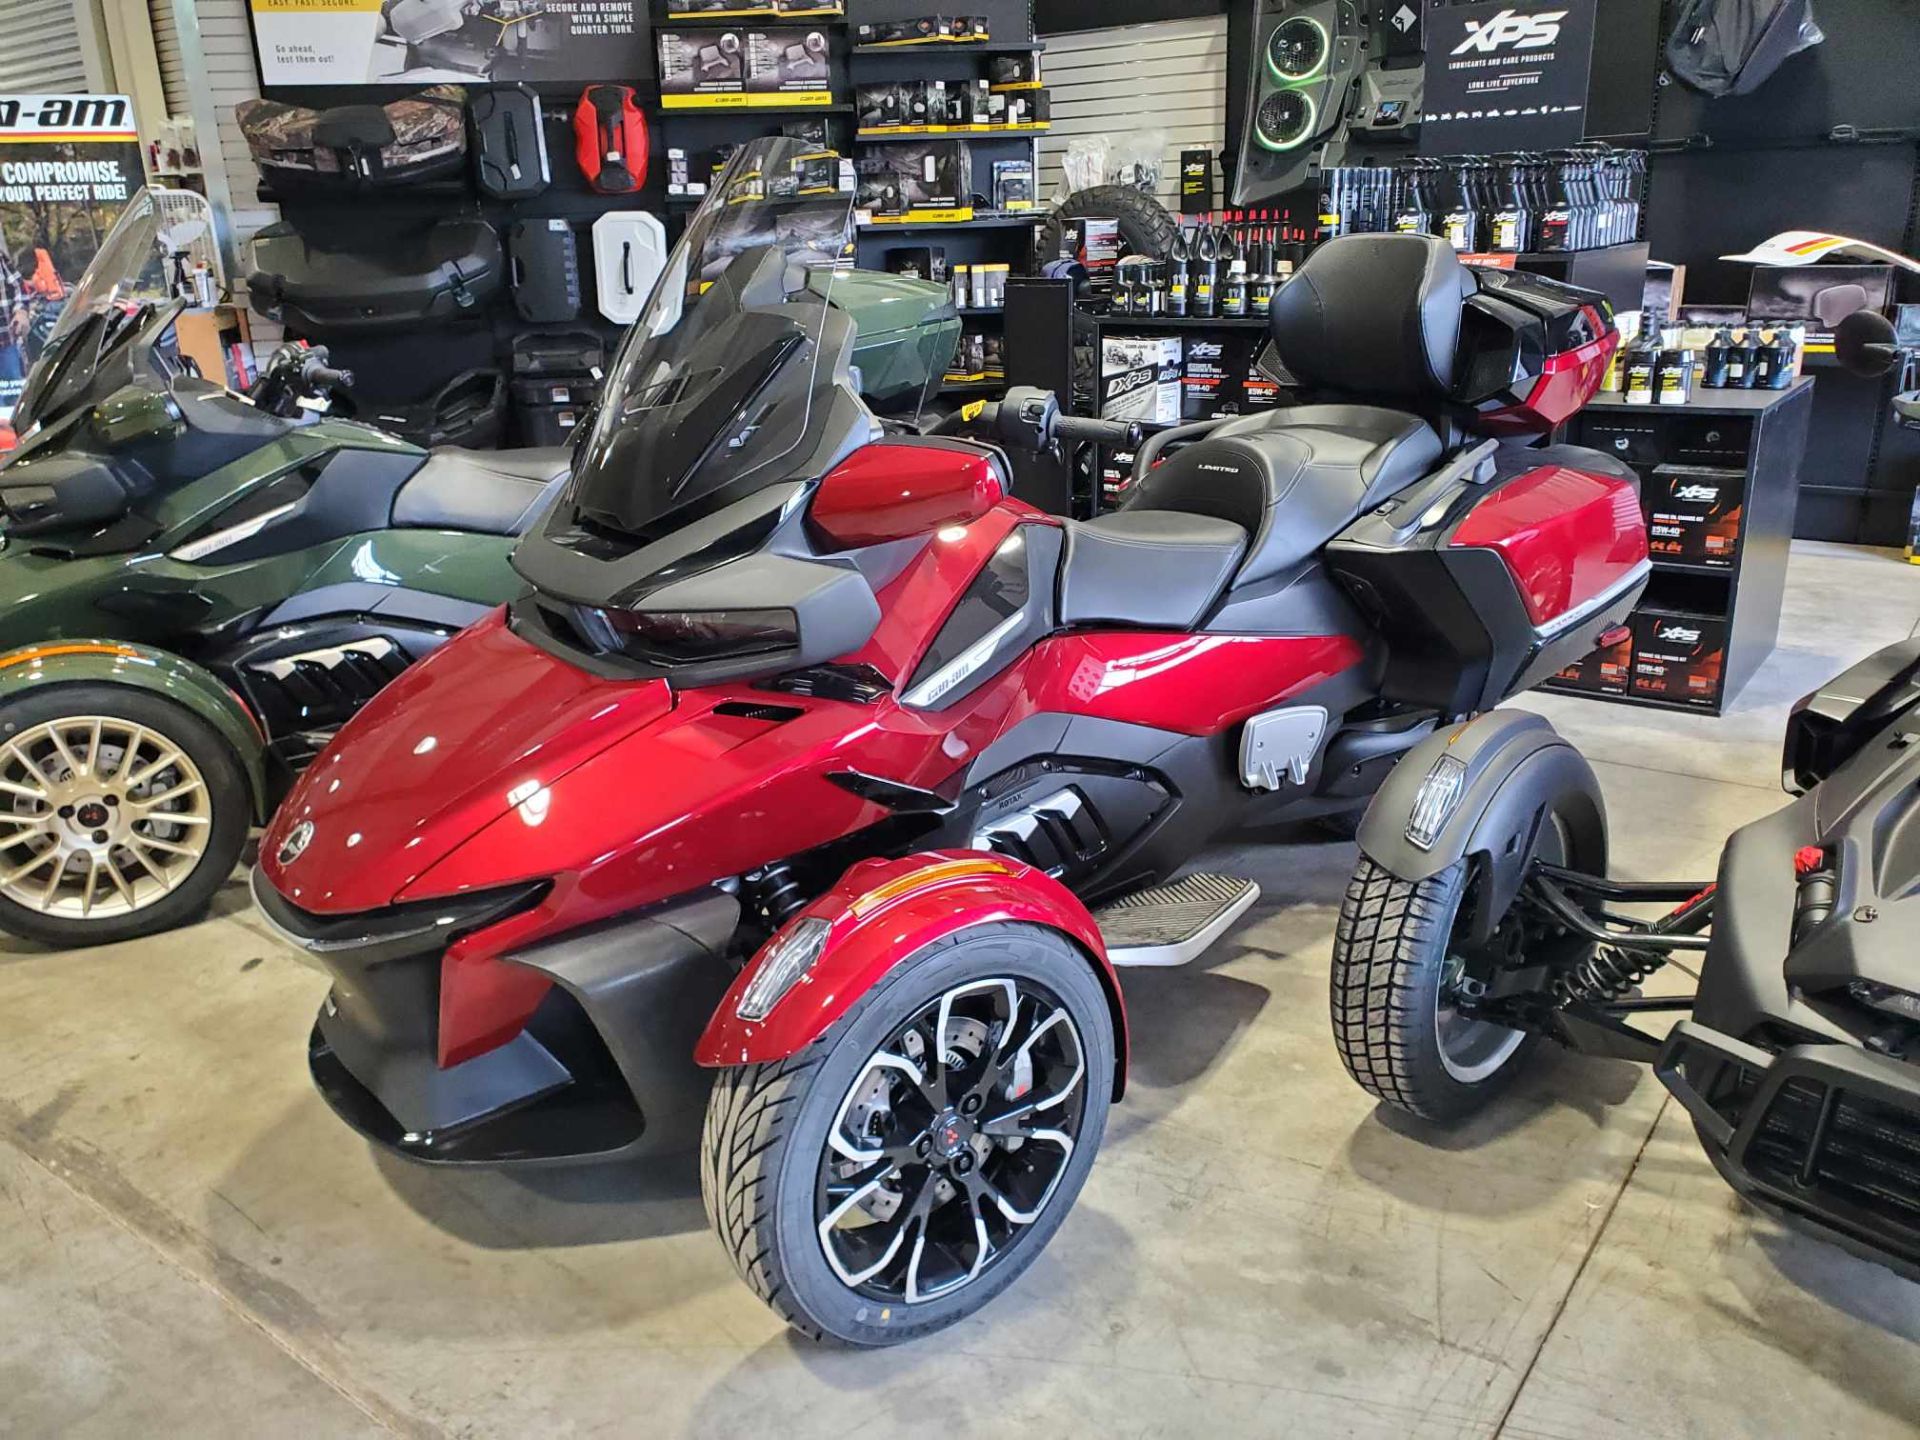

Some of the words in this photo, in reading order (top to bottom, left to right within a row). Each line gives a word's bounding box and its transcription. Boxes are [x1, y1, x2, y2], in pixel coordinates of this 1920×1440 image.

[546, 3, 578, 12] SECURE
[580, 3, 597, 12] AND
[600, 2, 633, 11] REMOVE
[571, 14, 593, 23] WITH
[596, 14, 601, 23] A
[604, 13, 634, 22] SIMPLE
[570, 25, 608, 34] QUARTER
[1450, 9, 1569, 55] XPS
[277, 55, 294, 63] test
[296, 55, 316, 63] them
[1448, 60, 1487, 70] LUBRICANTS
[1488, 58, 1501, 67] AND
[1503, 56, 1520, 65] CARE
[1521, 53, 1555, 63] PRODUCTS
[1468, 81, 1485, 89] LONG
[1487, 79, 1501, 88] LIVE
[1503, 76, 1539, 86] ADVENTURE
[2, 161, 127, 184] COMPROMISE.
[35, 185, 90, 201] PERFECT
[92, 184, 127, 200] RIDE!
[1491, 211, 1519, 222] XPS
[1542, 210, 1570, 221] XPS
[1189, 342, 1224, 355] XPS
[1116, 369, 1152, 391] XPS
[1198, 464, 1239, 473] LIMITED
[1675, 485, 1720, 499] XPS
[1659, 626, 1702, 641] XPS
